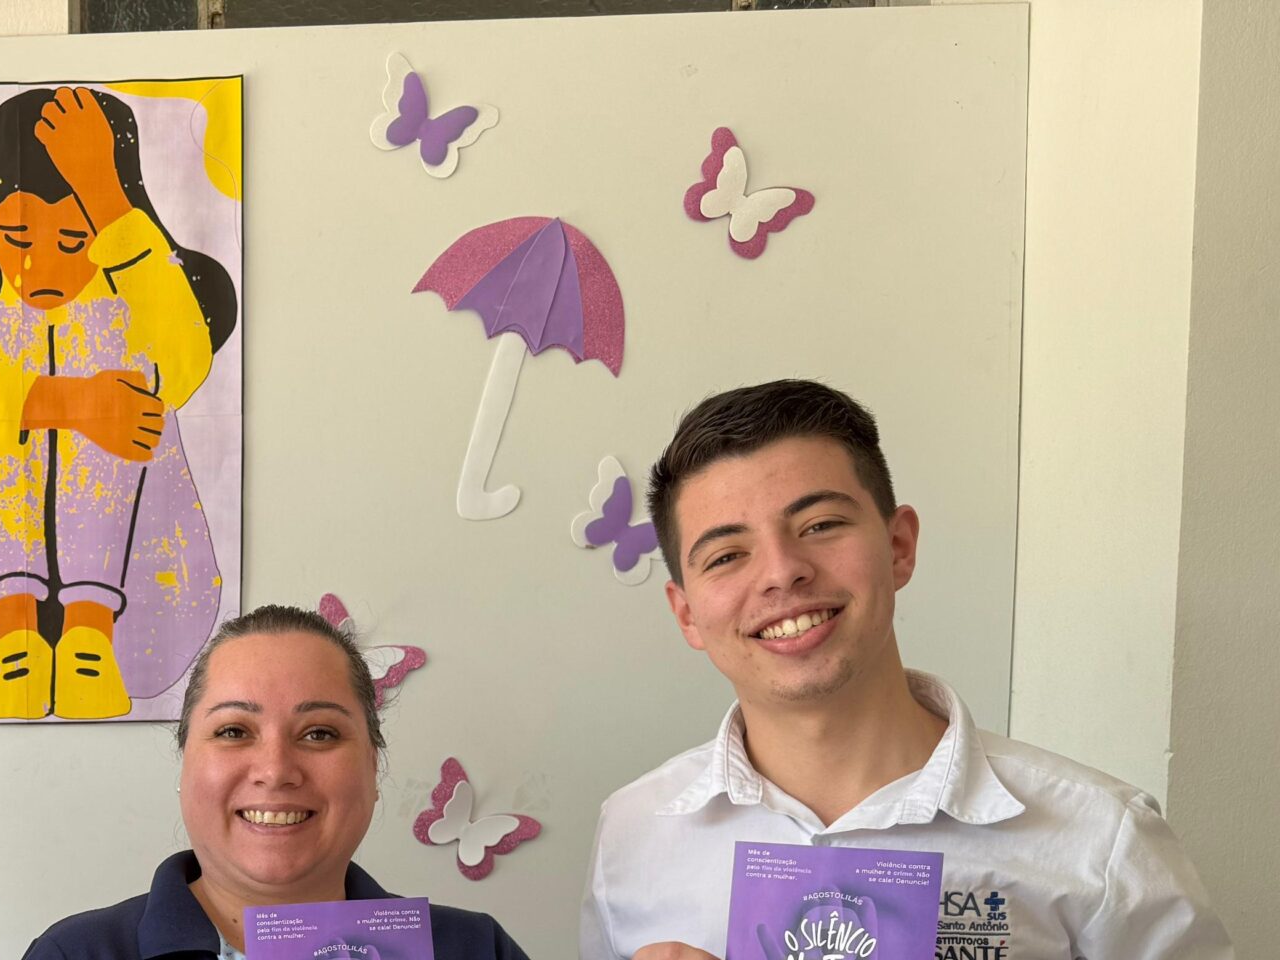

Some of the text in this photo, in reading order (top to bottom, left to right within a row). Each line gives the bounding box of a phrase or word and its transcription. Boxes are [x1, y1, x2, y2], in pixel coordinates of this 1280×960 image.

[803, 891, 863, 905] #AGOSTOLILÁS
[987, 912, 1007, 920] SUS
[937, 921, 1009, 931] Santo Antônio
[784, 911, 876, 957] O SILÊNCIO
[936, 936, 989, 945] STITUTO/OS
[313, 944, 367, 956] #AGOSTOLILÁS
